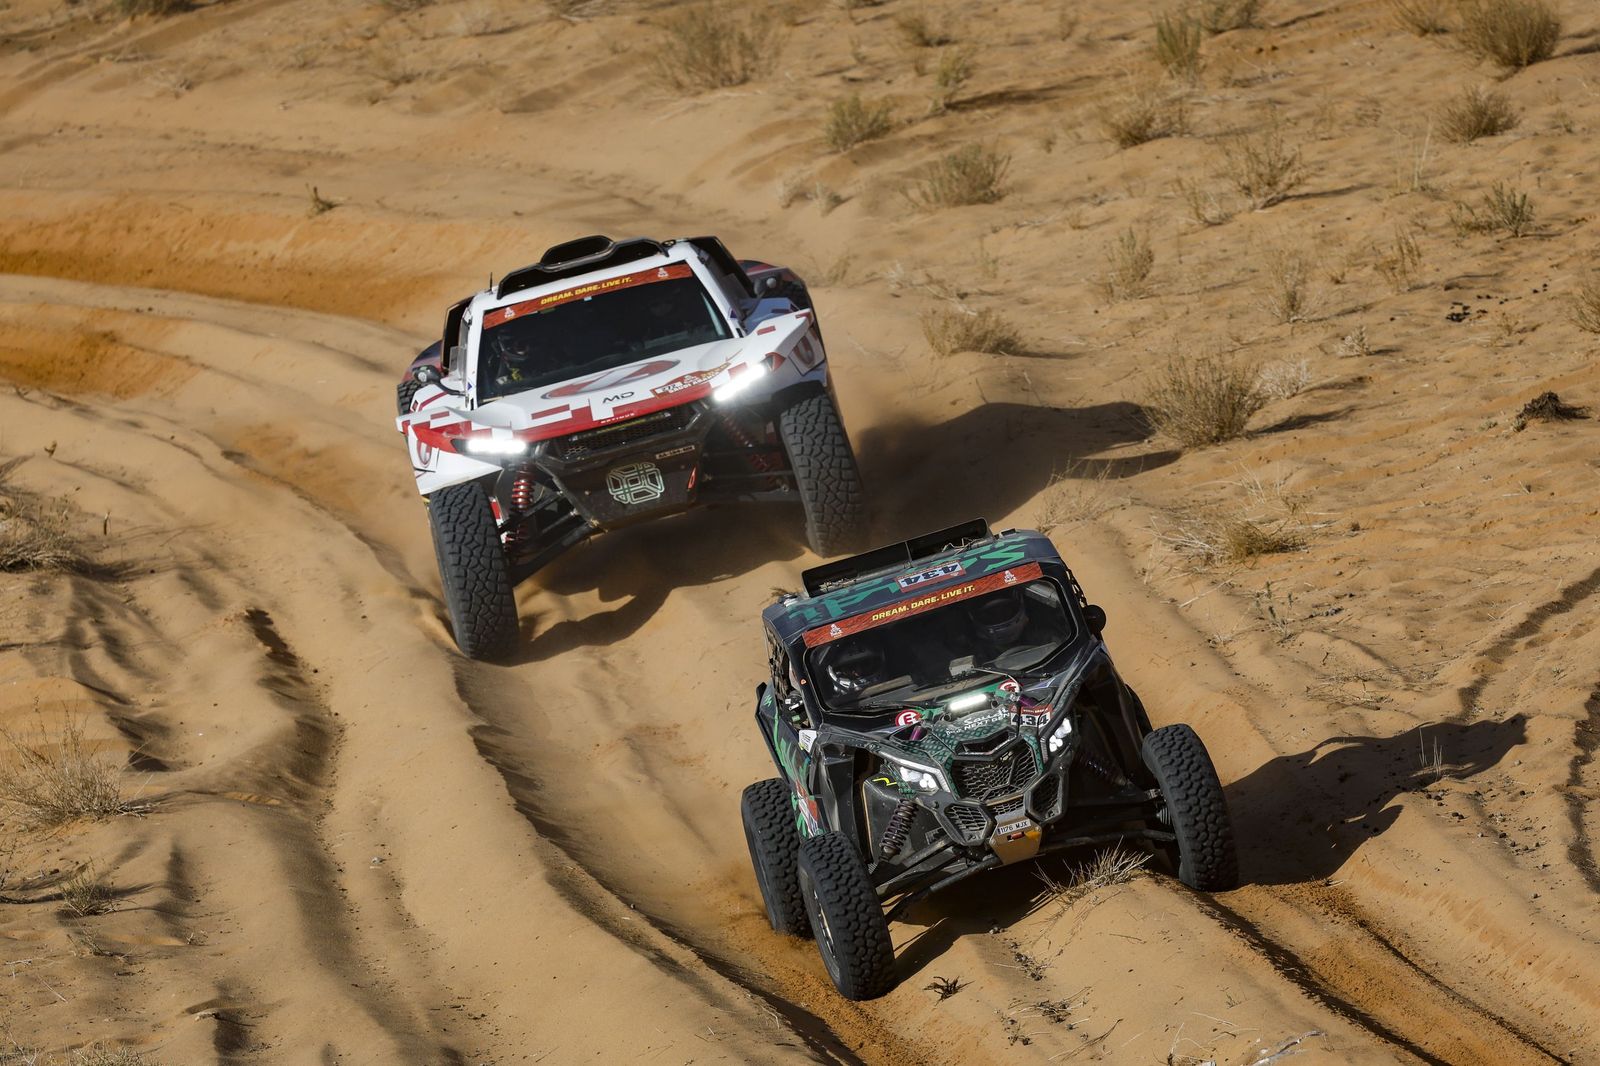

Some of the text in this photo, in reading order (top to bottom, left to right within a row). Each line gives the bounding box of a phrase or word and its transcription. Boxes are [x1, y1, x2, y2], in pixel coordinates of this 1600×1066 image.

[540, 276, 632, 305] DREAM. DARE. LIVE IT.
[901, 563, 963, 586] 434
[872, 584, 976, 622] DREAM. DARE. LIVE IT.
